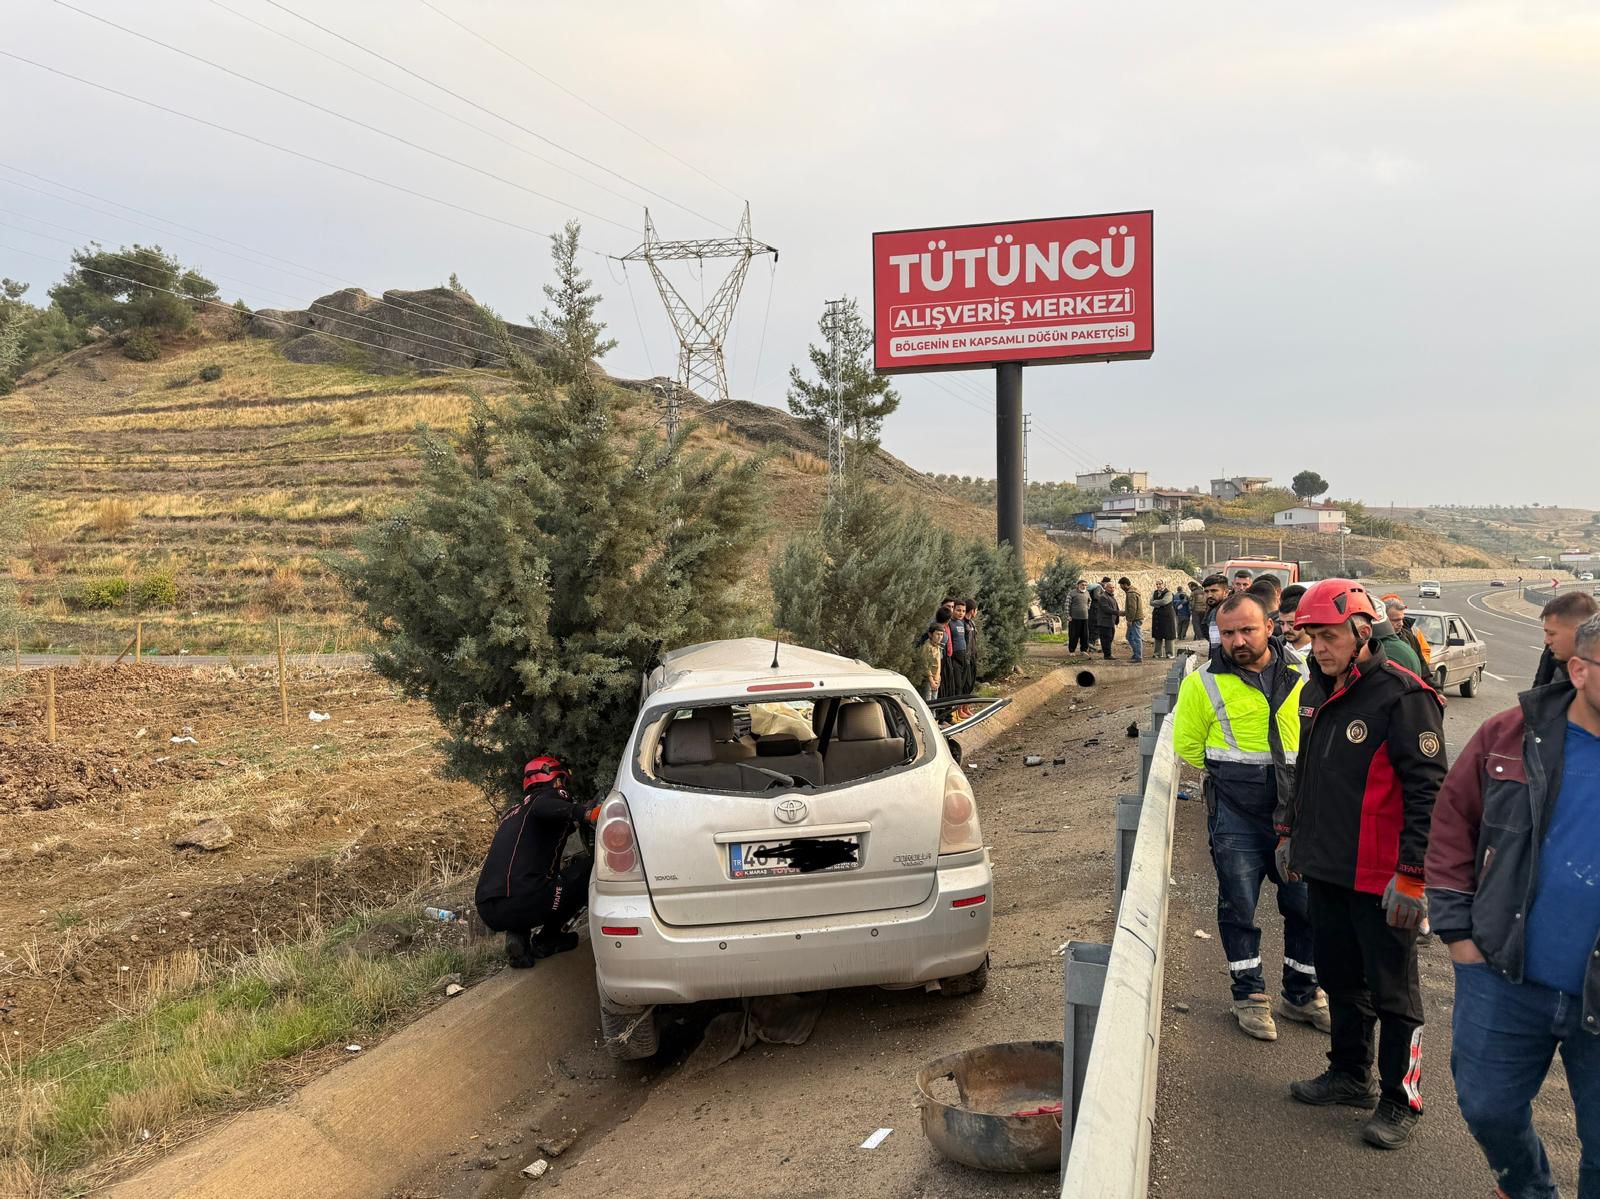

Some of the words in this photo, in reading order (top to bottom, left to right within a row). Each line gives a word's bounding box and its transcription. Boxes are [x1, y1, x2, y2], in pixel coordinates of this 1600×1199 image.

[889, 225, 1136, 294] TÜTÜNCÜ
[894, 296, 1015, 331] ALIŞVERİŞ
[1022, 287, 1132, 319] MERKEZİ
[895, 338, 949, 353] BÖLGENİN
[952, 336, 967, 349] EN
[970, 334, 1025, 347] KAPSAMLI
[1028, 328, 1068, 343] DÜĞÜN
[1072, 325, 1130, 342] PAKETÇİSİ
